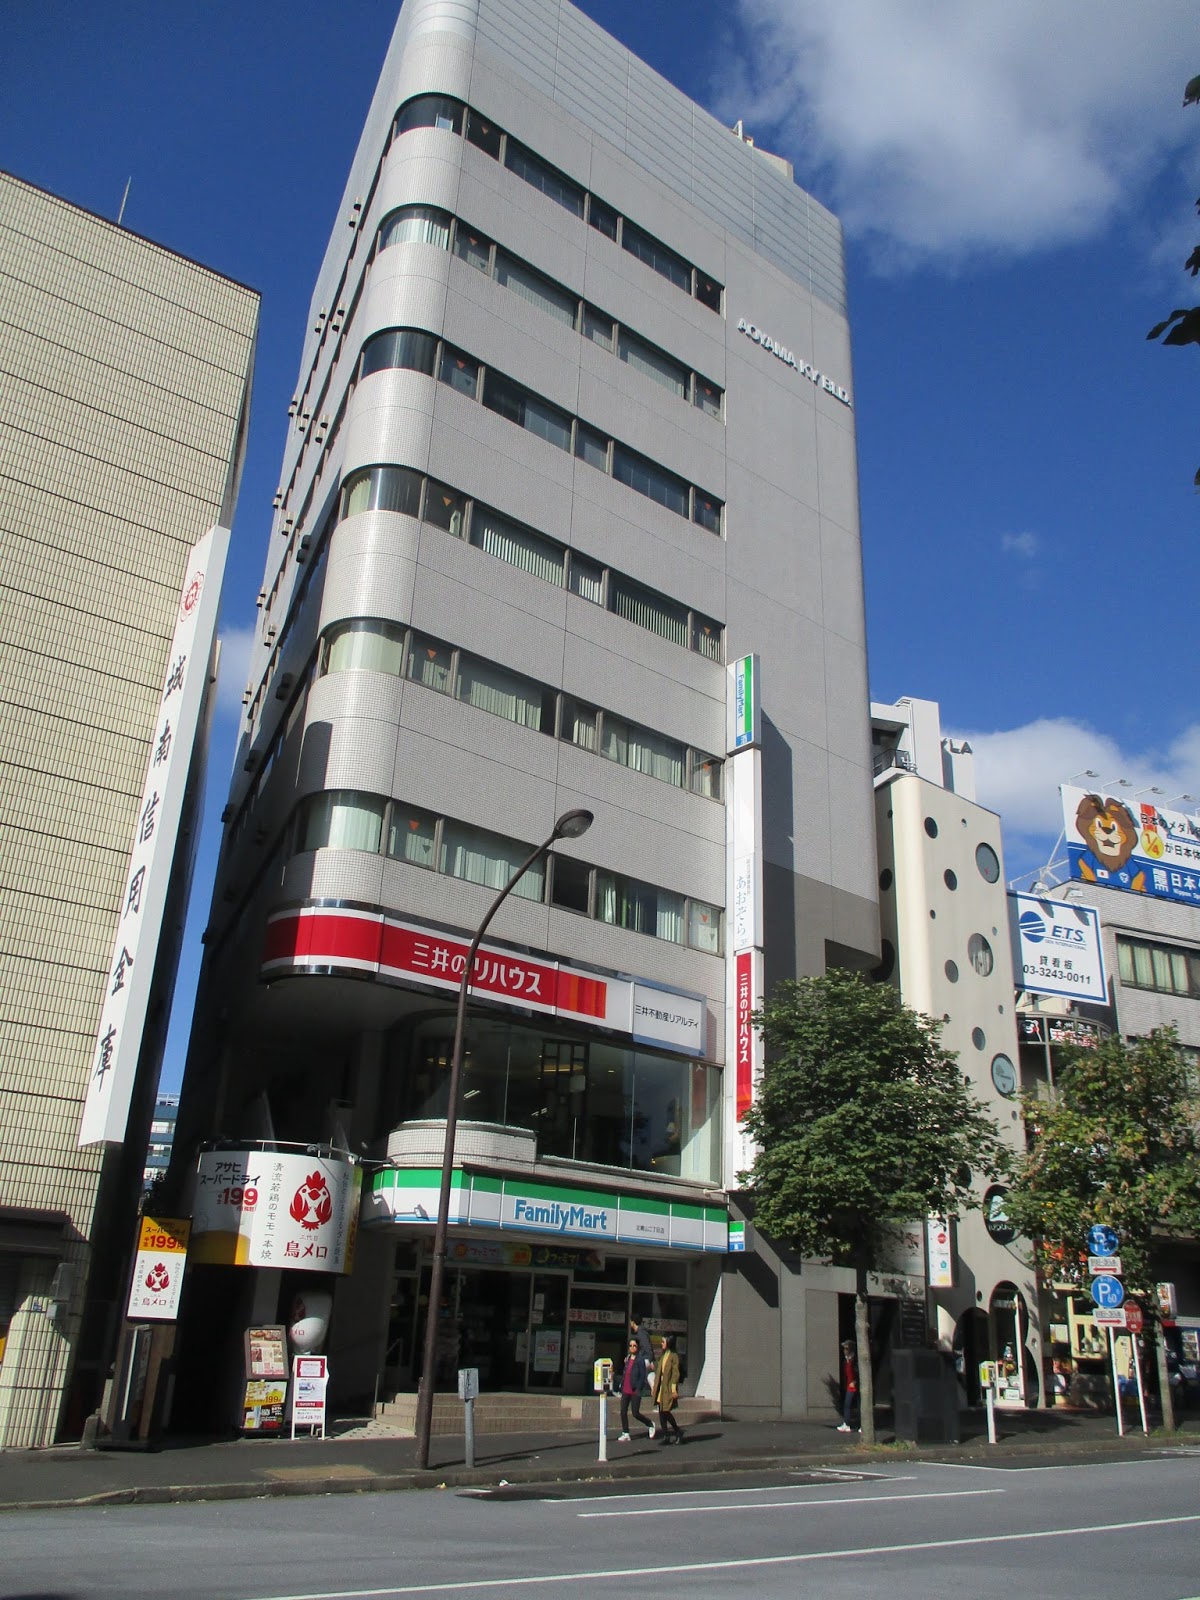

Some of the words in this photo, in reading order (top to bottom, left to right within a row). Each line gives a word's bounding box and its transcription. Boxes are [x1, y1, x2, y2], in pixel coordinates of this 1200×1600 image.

[737, 317, 798, 371] AOYAMA
[799, 359, 820, 385] KY
[737, 674, 745, 719] FamilyMart
[92, 656, 185, 1093] 城南信用金庫
[1171, 873, 1200, 891] 日本
[736, 875, 748, 936] あおぞら
[1051, 925, 1086, 943] E.T.S.
[411, 942, 541, 995] 三井のリハウス
[1023, 964, 1091, 984] 03-3243-0011
[635, 1004, 699, 1029] 三井不動産リアルティ
[740, 973, 749, 1063] 三井のリハウス
[214, 1162, 242, 1172] アサヒ
[200, 1175, 261, 1186] スーパードライ
[223, 1187, 258, 1206] 199
[515, 1199, 607, 1230] FamilyMart
[284, 1240, 328, 1259] 鳥メロ
